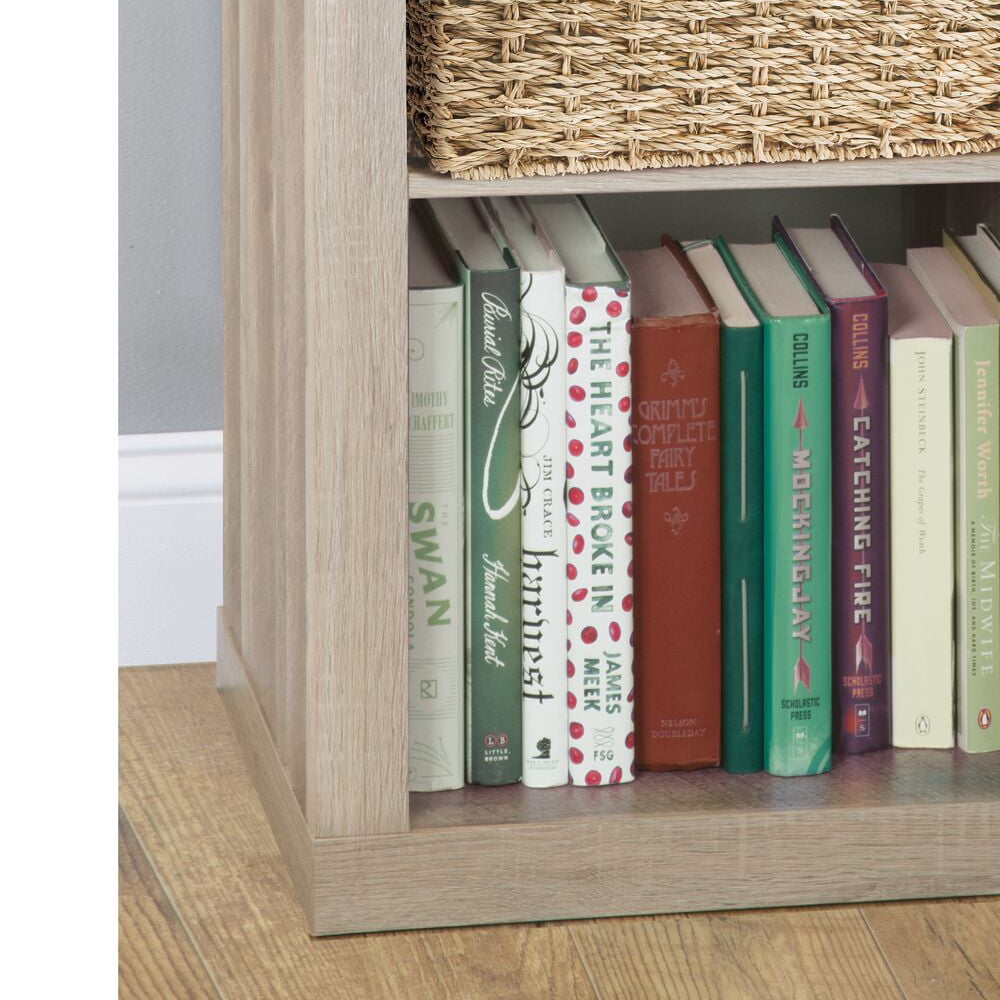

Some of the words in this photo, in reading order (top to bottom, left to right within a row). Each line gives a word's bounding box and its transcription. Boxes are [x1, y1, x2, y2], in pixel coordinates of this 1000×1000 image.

[481, 292, 512, 356] Burial
[590, 321, 612, 371] THE
[853, 313, 868, 370] COLLINS
[481, 356, 506, 408] Rites
[793, 333, 809, 389] COLLINS
[914, 351, 926, 382] JOHN
[638, 397, 708, 421] GRIMM'S
[917, 387, 927, 454] STEINBECK
[975, 360, 992, 434] Jennifer
[590, 381, 613, 477] HEART
[632, 420, 717, 445] COMPLETE
[543, 455, 552, 481] JIM
[645, 470, 697, 493] TALES
[649, 446, 697, 469] FAIRY
[853, 416, 871, 550] CATCHING
[977, 440, 992, 500] Worth
[543, 488, 552, 538] CRACE
[590, 486, 613, 575] BROKE
[408, 502, 451, 626] SWAN
[792, 450, 811, 642] MOCKINGJAY
[482, 553, 510, 623] Hannah
[591, 585, 614, 612] IN
[854, 563, 872, 625] FIRE
[483, 622, 508, 667] Kent
[980, 560, 996, 676] MIDWIFE
[584, 658, 601, 711] MEEK
[603, 651, 622, 715] JAMES
[781, 697, 820, 709] SCHOLASTIC
[852, 687, 874, 698] PRESS
[790, 710, 811, 720] PRESS
[593, 750, 614, 761] FSG
